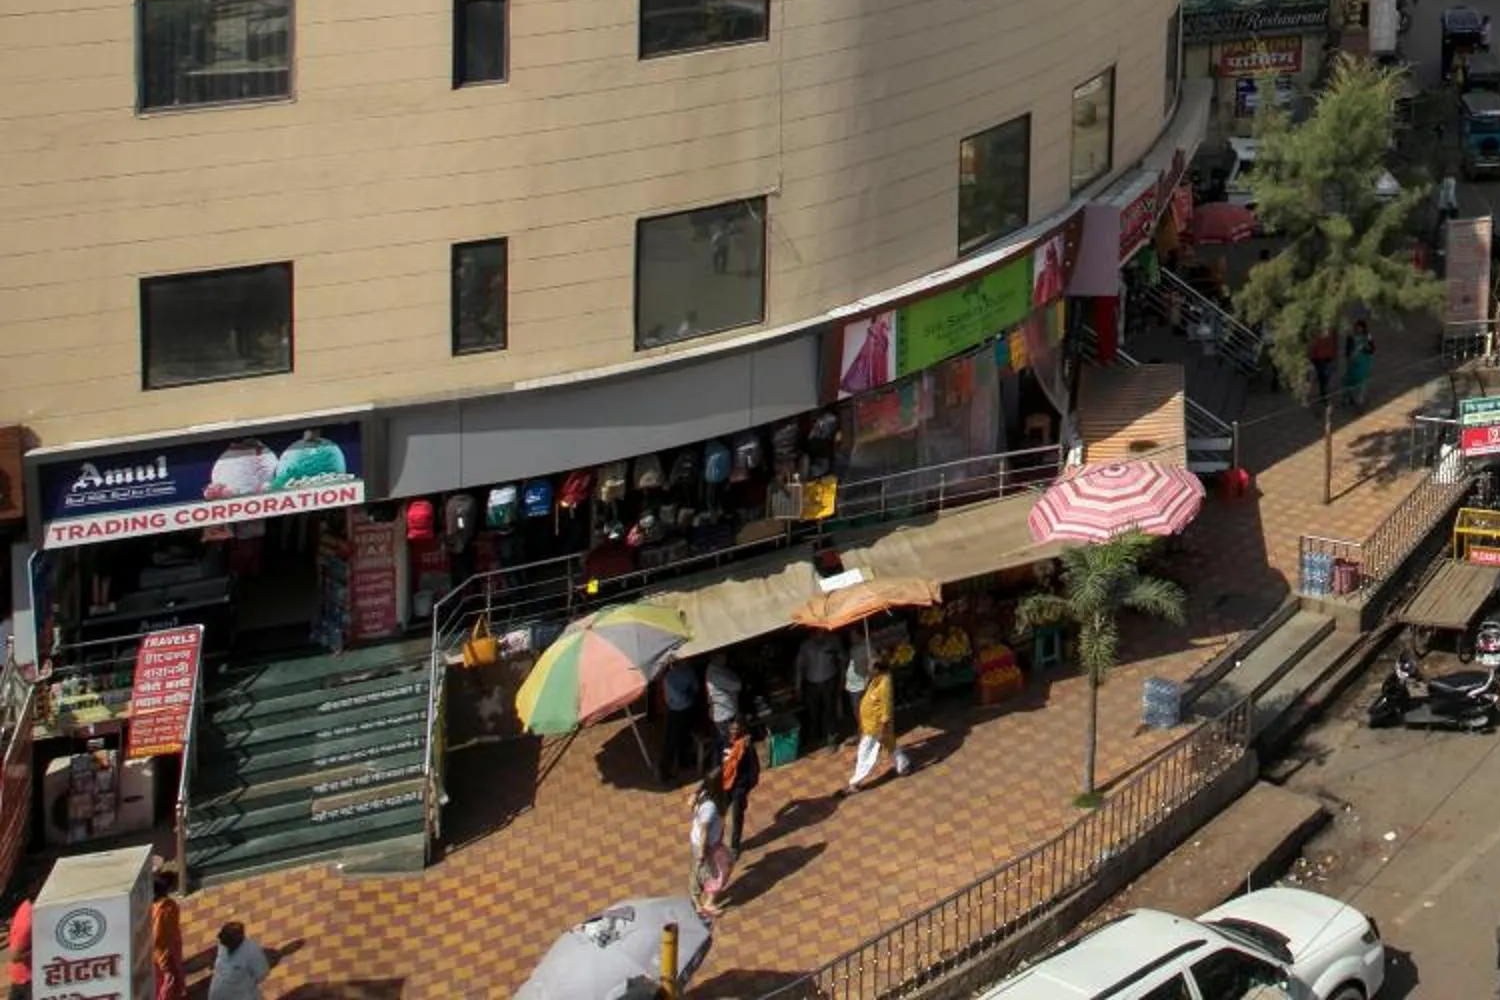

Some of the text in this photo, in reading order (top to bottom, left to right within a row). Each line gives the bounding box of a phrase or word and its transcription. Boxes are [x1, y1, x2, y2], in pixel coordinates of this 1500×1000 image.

[1247, 8, 1328, 28] Restaurant
[71, 455, 169, 493] Amul
[52, 487, 357, 541] TRADING CORPORATION
[144, 633, 197, 648] TRAVELS
[42, 954, 122, 986] होटल
